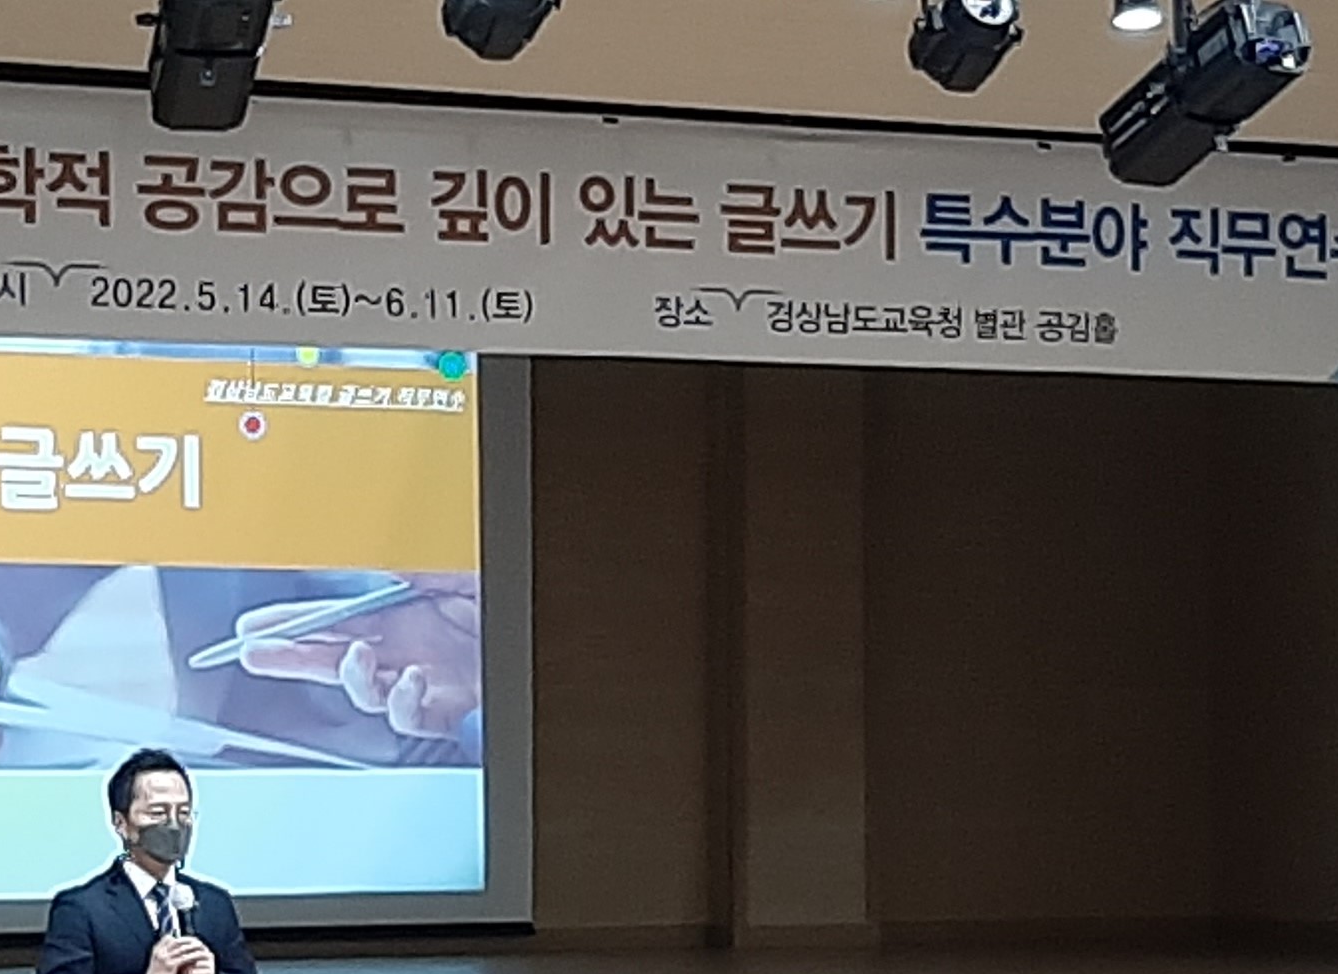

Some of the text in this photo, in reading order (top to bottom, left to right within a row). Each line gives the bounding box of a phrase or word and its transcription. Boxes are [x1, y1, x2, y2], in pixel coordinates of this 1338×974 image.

[136, 153, 405, 235] 공감으로
[430, 168, 551, 246] 깊이
[579, 175, 700, 250] 있는
[720, 182, 896, 261] 글쓰기
[919, 192, 1150, 272] 특수분야
[654, 295, 714, 329] 장소
[766, 300, 963, 339] 경상남도교육청
[974, 308, 1026, 341] 별관
